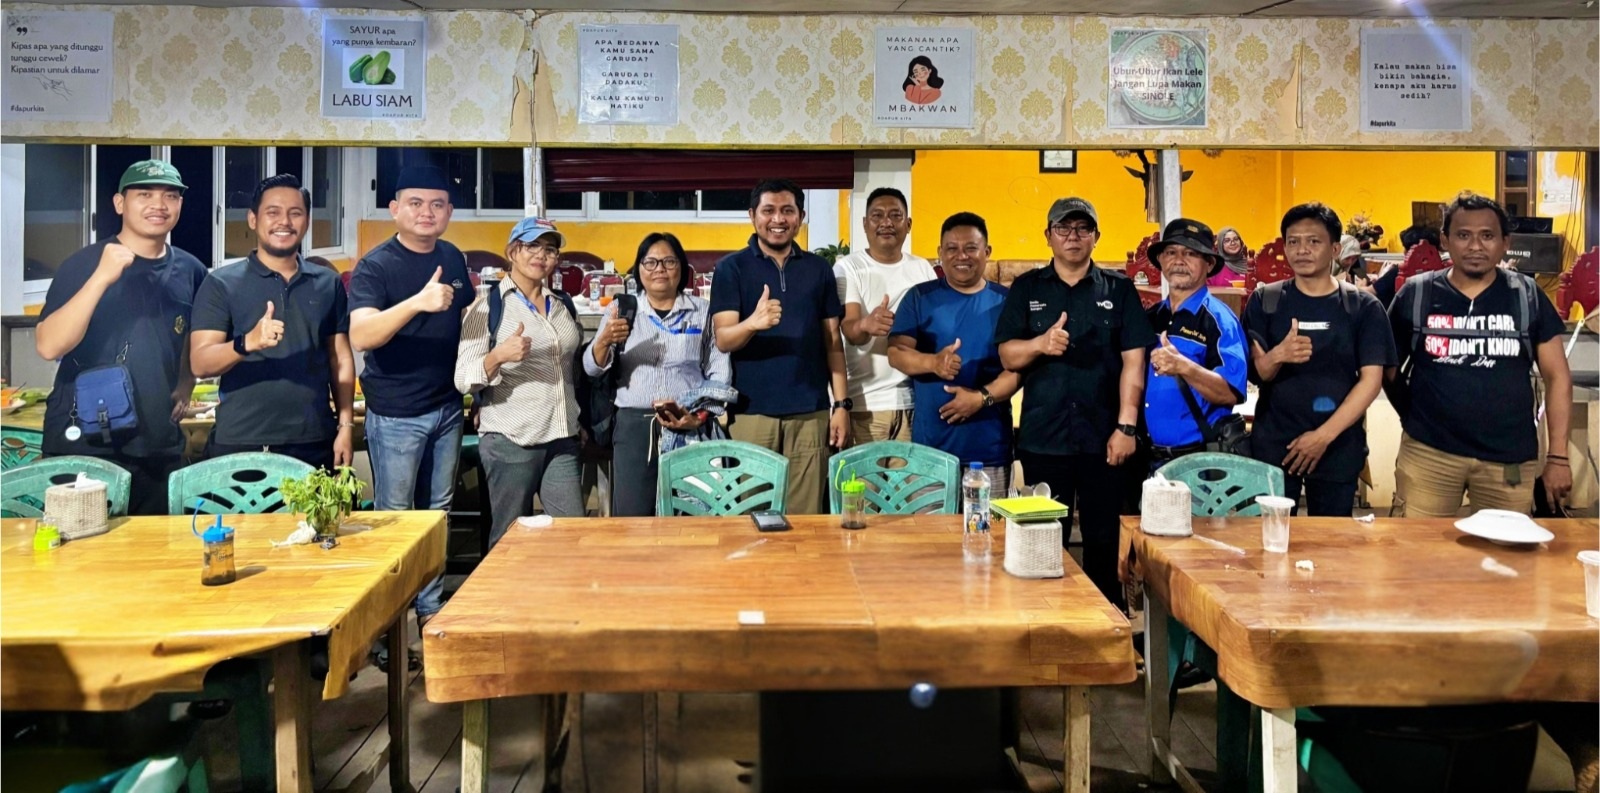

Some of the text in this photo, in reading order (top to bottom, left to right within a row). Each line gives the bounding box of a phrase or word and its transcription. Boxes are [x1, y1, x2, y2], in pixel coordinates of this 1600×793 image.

[11, 42, 31, 51] Kipas
[70, 43, 103, 52] ditunggu
[11, 65, 45, 74] Kipastian
[1113, 68, 1160, 76] Ubur-Ubur
[1113, 80, 1144, 89] Jangan
[1148, 80, 1168, 89] Lupa
[333, 94, 412, 107] LABU SIAM
[1425, 336, 1448, 356] 50%
[1488, 338, 1520, 356] KNOW
